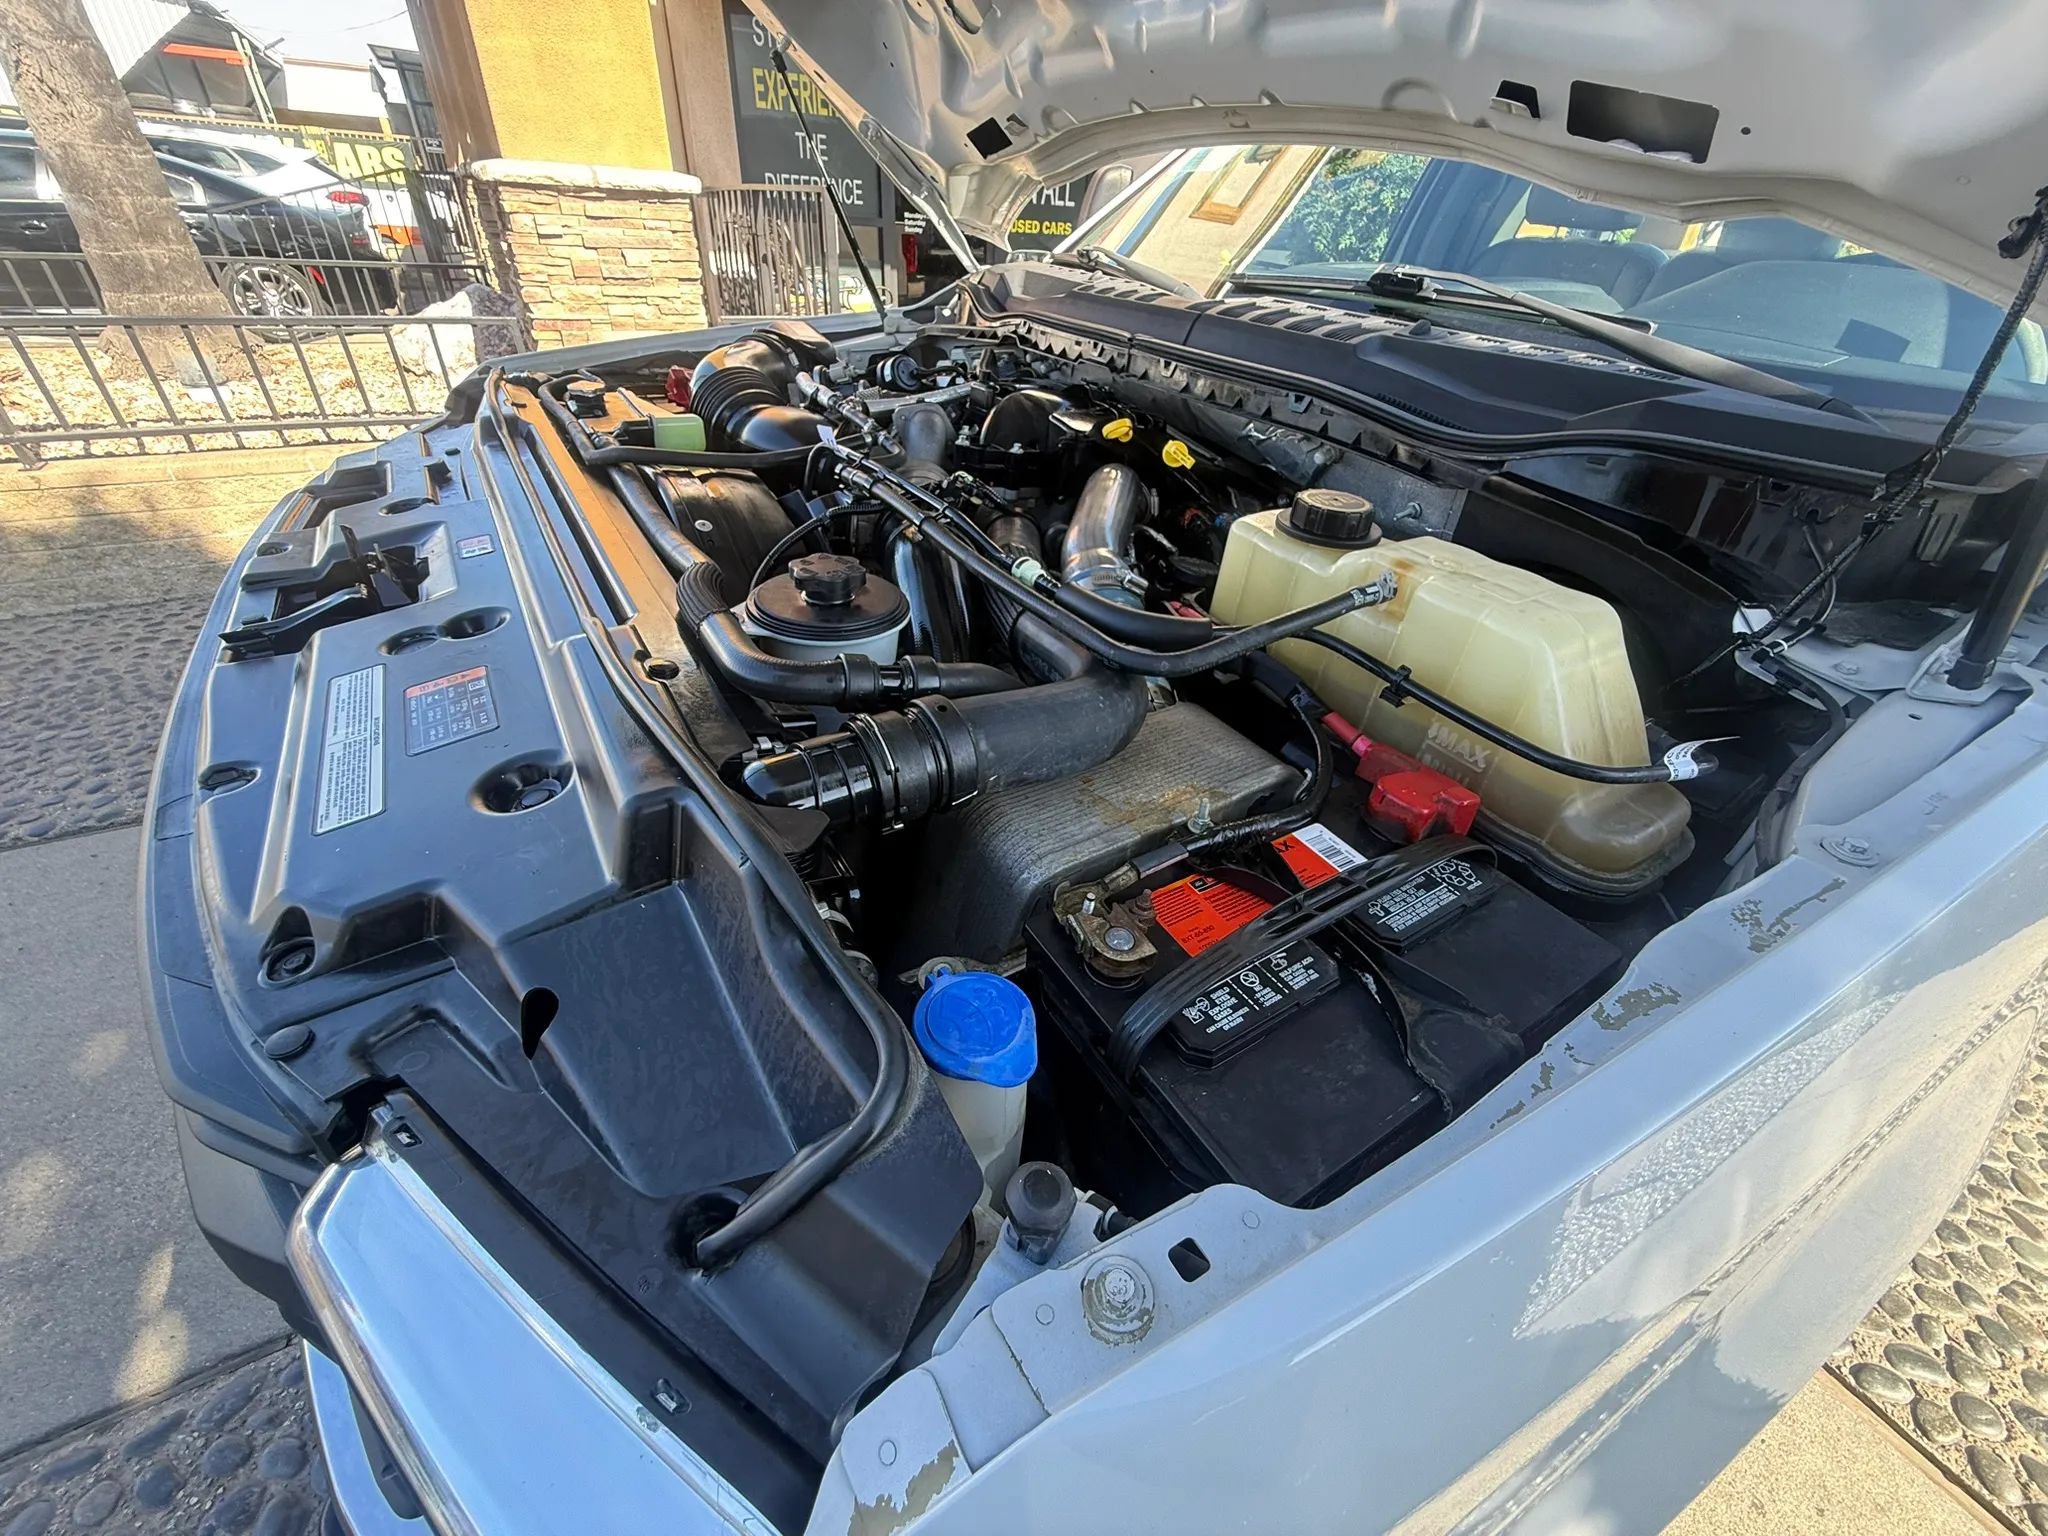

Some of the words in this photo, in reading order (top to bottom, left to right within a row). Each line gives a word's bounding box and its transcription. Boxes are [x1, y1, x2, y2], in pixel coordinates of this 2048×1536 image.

[795, 131, 828, 160] THE
[333, 142, 407, 184] ARS
[1042, 221, 1072, 236] CARS
[1435, 726, 1491, 768] MAX
[1209, 986, 1230, 999] SHIELD
[1253, 983, 1263, 991] NO
[1208, 996, 1238, 1016] EXPLOSIVE
[1214, 993, 1230, 1004] EYES
[1213, 1007, 1232, 1020] GASES
